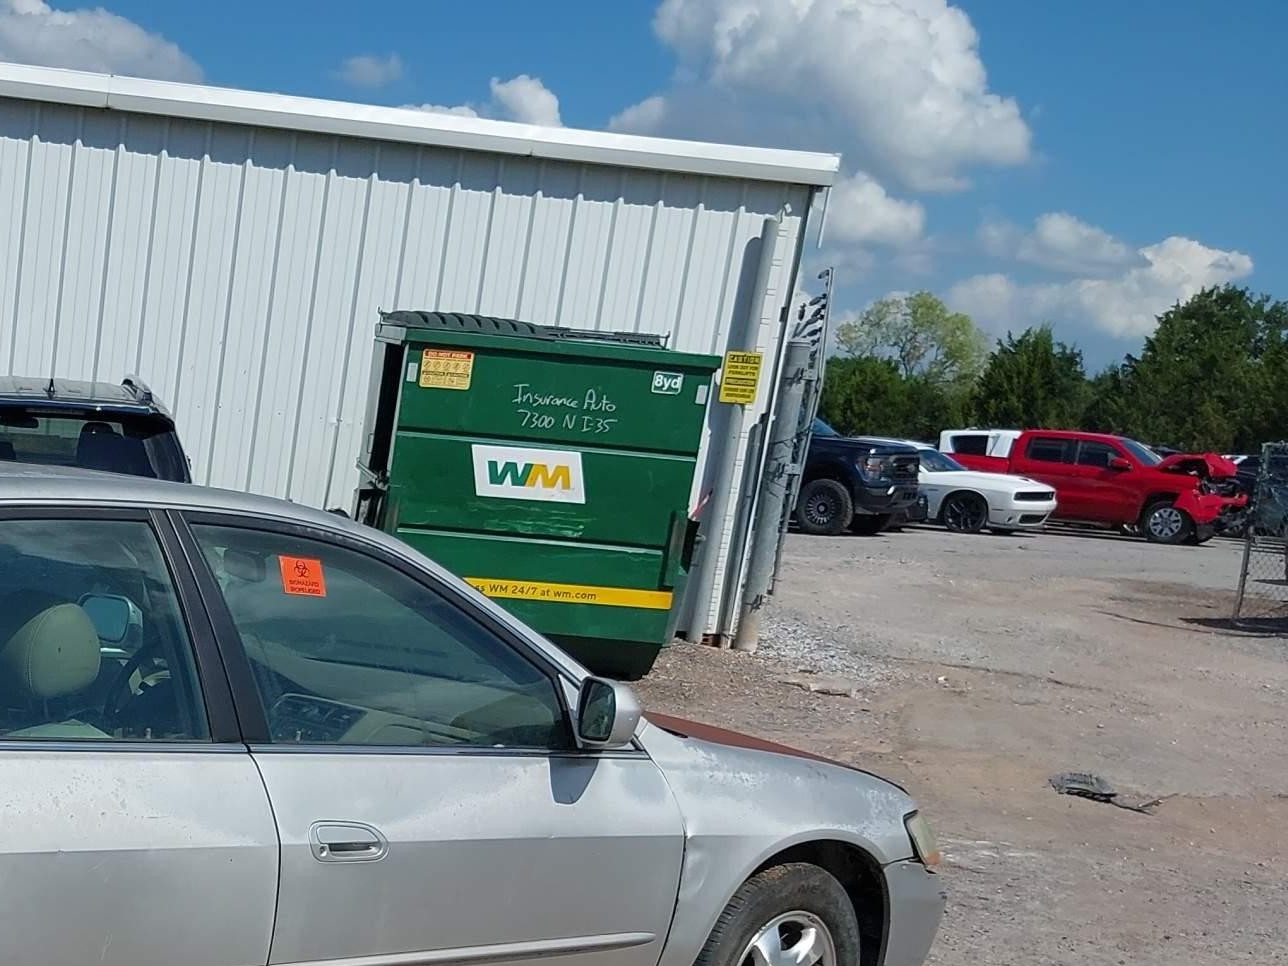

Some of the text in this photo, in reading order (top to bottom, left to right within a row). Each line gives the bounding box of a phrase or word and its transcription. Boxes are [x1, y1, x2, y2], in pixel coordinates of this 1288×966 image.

[654, 374, 682, 391] 8yd
[512, 384, 617, 412] Insurance Auto
[517, 409, 555, 429] 7300
[562, 413, 578, 430] N
[487, 460, 571, 491] WM
[489, 584, 509, 593] WM
[511, 585, 538, 596] 24/7
[540, 588, 550, 597] at
[553, 590, 597, 601] wm.com
